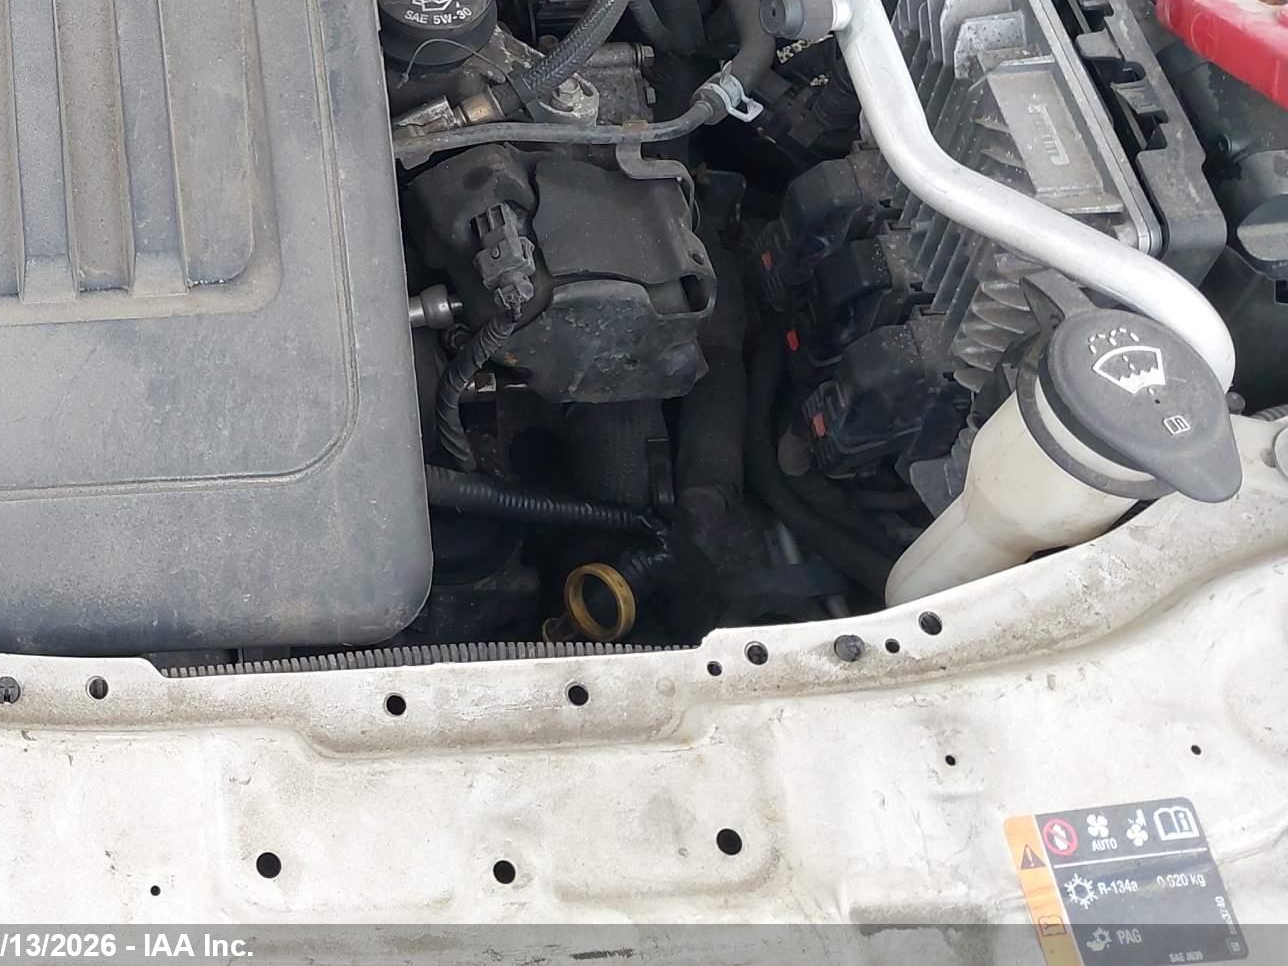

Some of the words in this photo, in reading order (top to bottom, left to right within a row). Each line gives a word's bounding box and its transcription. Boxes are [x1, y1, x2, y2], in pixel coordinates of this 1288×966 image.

[404, 10, 428, 24] SAE
[433, 7, 472, 25] 5W-30
[1092, 838, 1118, 852] AUTO
[1097, 880, 1138, 895] R-134a
[1190, 874, 1207, 888] kg
[1116, 928, 1142, 945] PAG
